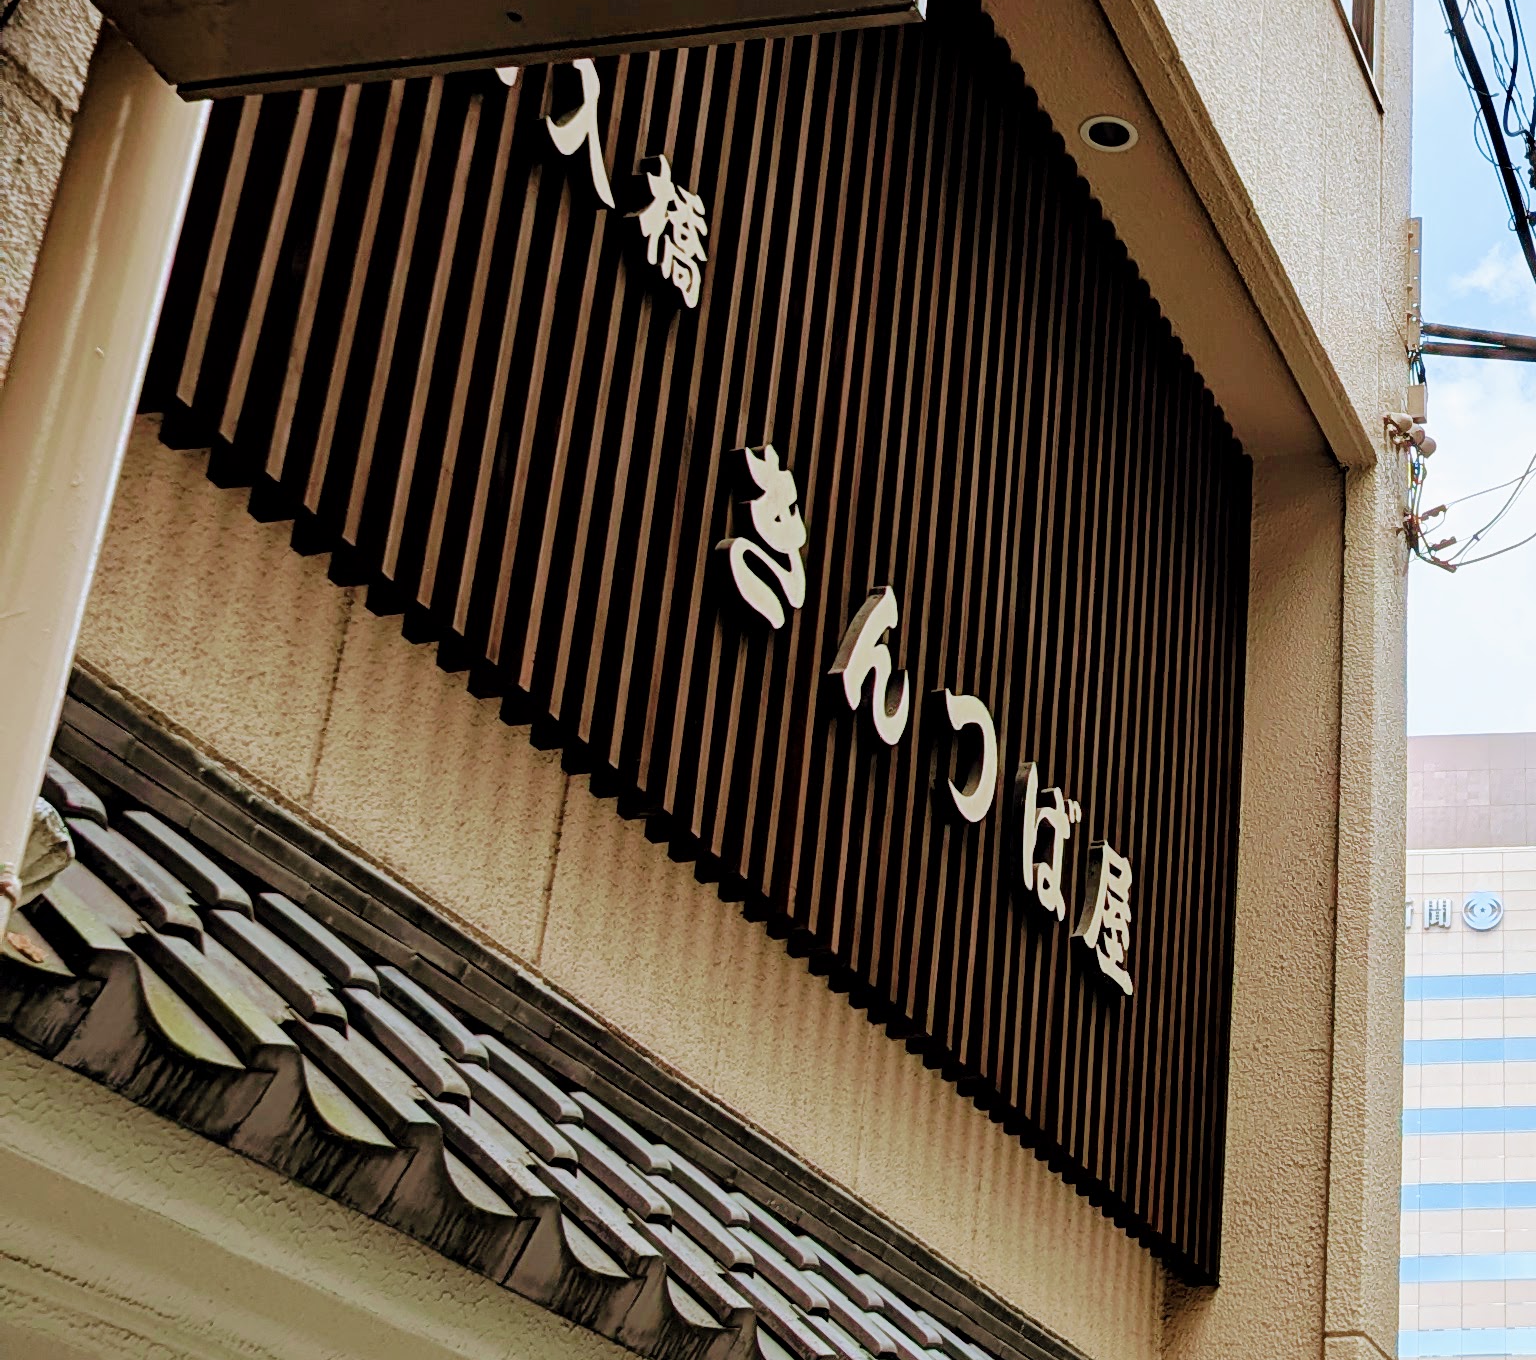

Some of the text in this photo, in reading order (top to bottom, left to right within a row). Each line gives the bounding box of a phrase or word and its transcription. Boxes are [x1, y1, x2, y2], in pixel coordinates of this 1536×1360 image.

[730, 445, 1132, 995] きんつば屋
